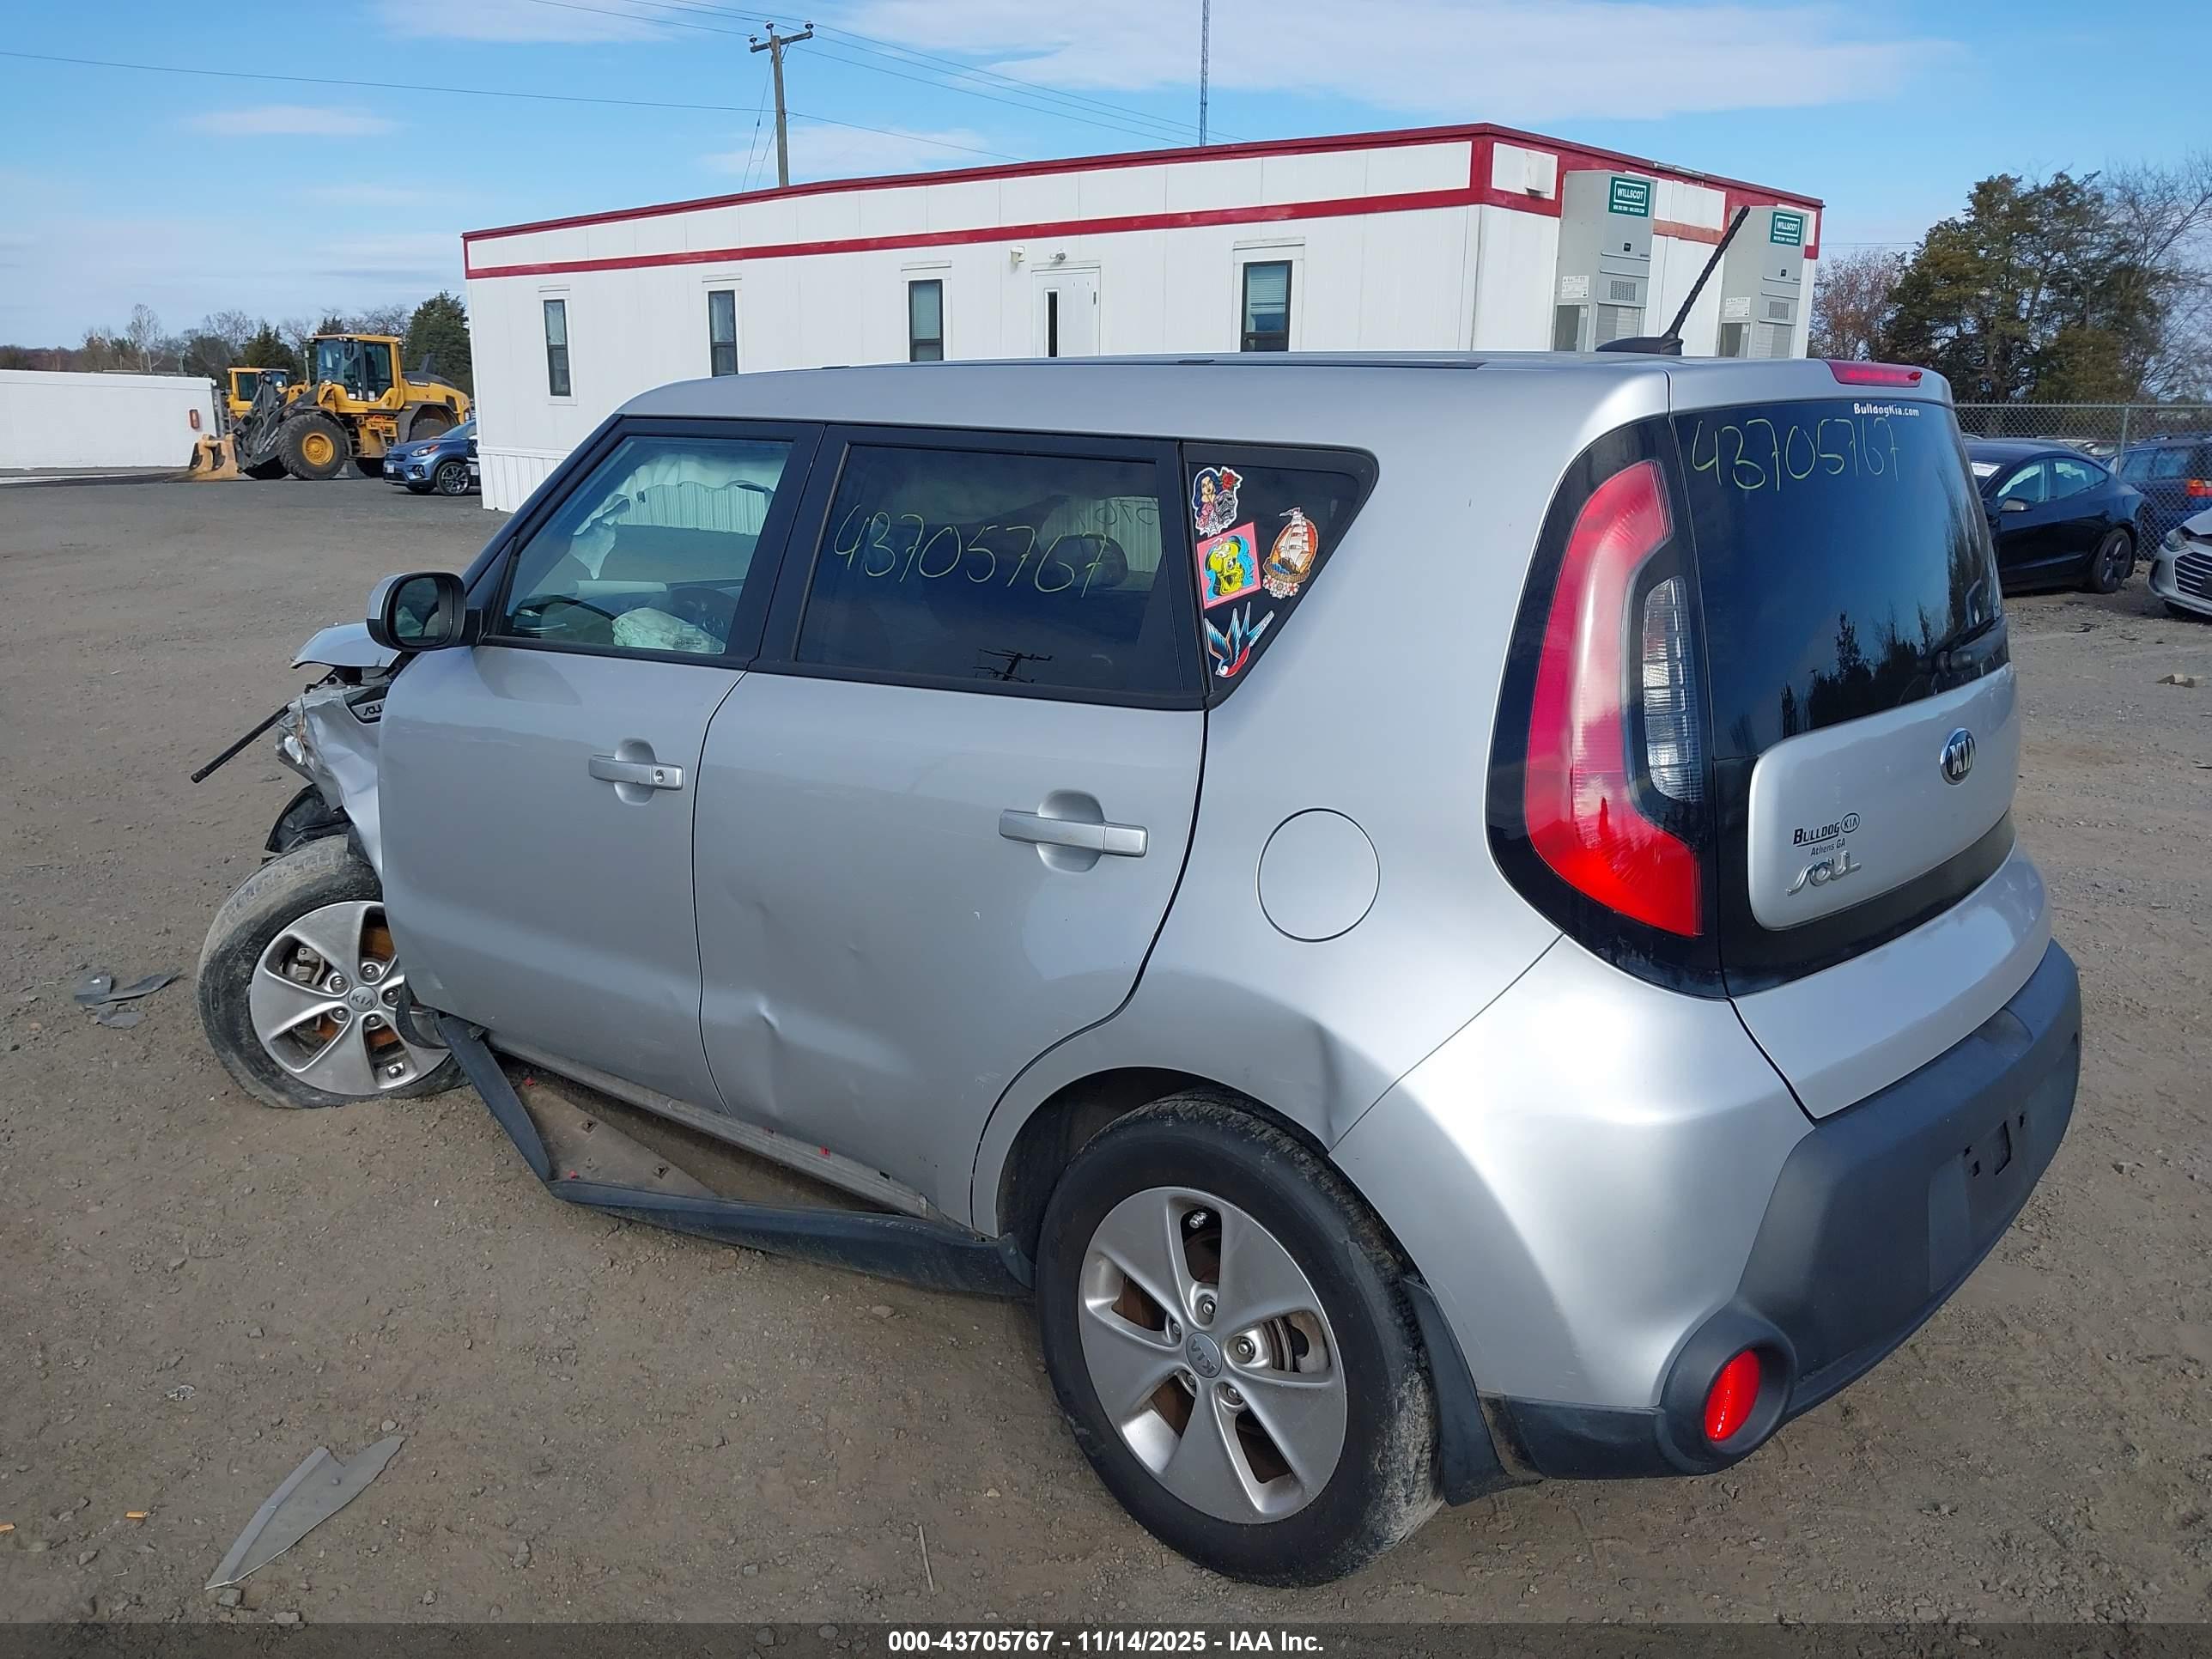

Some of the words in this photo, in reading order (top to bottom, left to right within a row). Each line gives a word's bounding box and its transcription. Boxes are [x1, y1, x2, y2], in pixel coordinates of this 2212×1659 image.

[1617, 186, 1644, 200] WILLSCOT
[1777, 221, 1798, 232] WILLSCOT
[1853, 402, 1920, 417] BulldogKia.com
[1692, 416, 1900, 492] 43705767
[833, 503, 1109, 599] 43705767
[1949, 738, 1976, 775] KIA
[1844, 817, 1858, 831] KIA
[1810, 842, 1835, 857] Athens
[1836, 840, 1846, 850] GA
[1786, 850, 1863, 896] SOUL
[352, 994, 374, 1006] KIA
[1191, 1337, 1217, 1374] KIA
